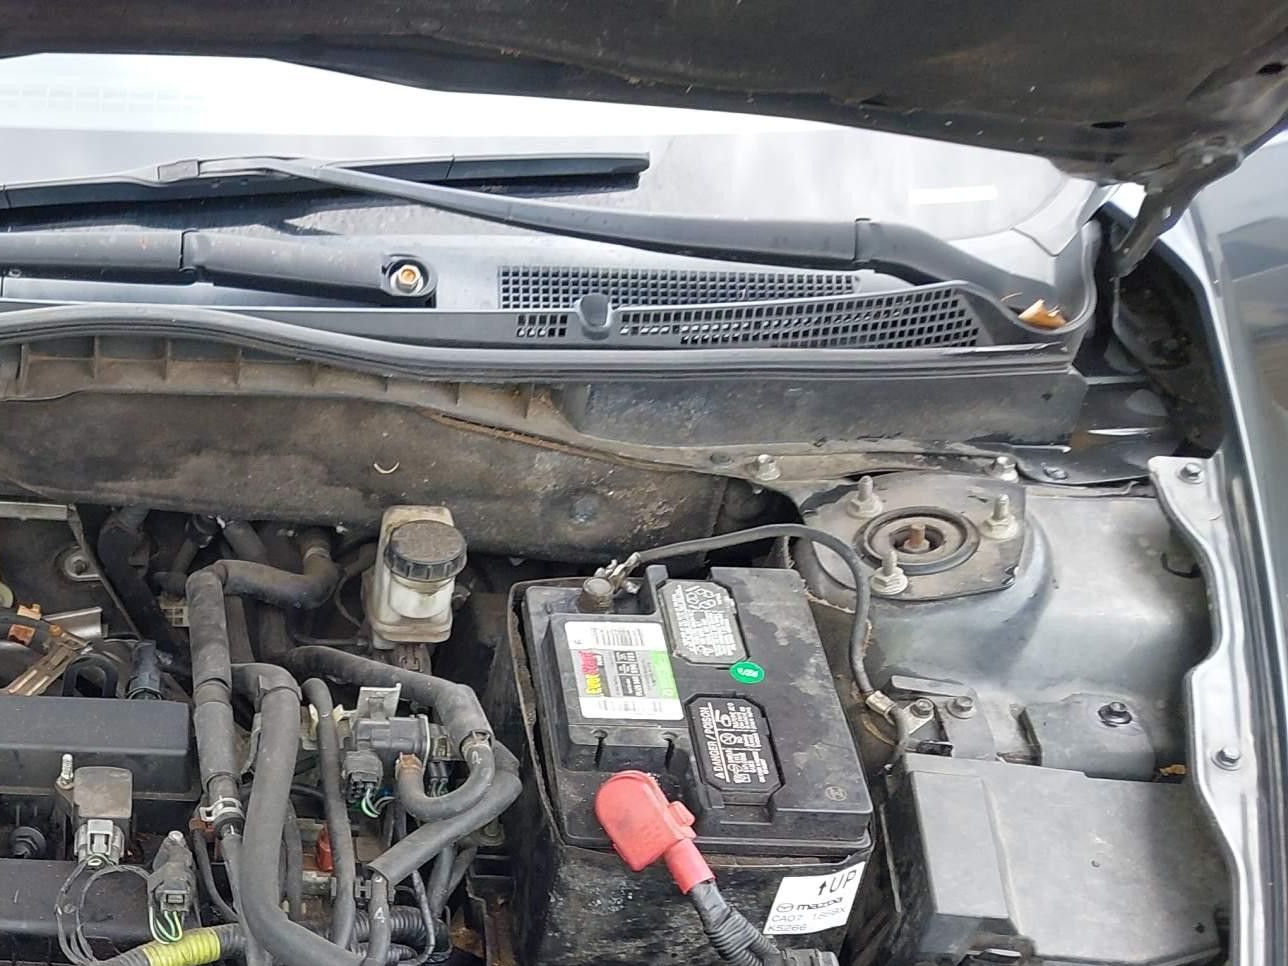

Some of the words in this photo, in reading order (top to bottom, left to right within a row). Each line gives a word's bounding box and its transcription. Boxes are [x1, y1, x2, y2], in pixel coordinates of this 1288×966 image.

[699, 706, 715, 735] POISON
[707, 741, 723, 772] DANGER
[830, 869, 857, 893] UP
[797, 897, 843, 911] mazda
